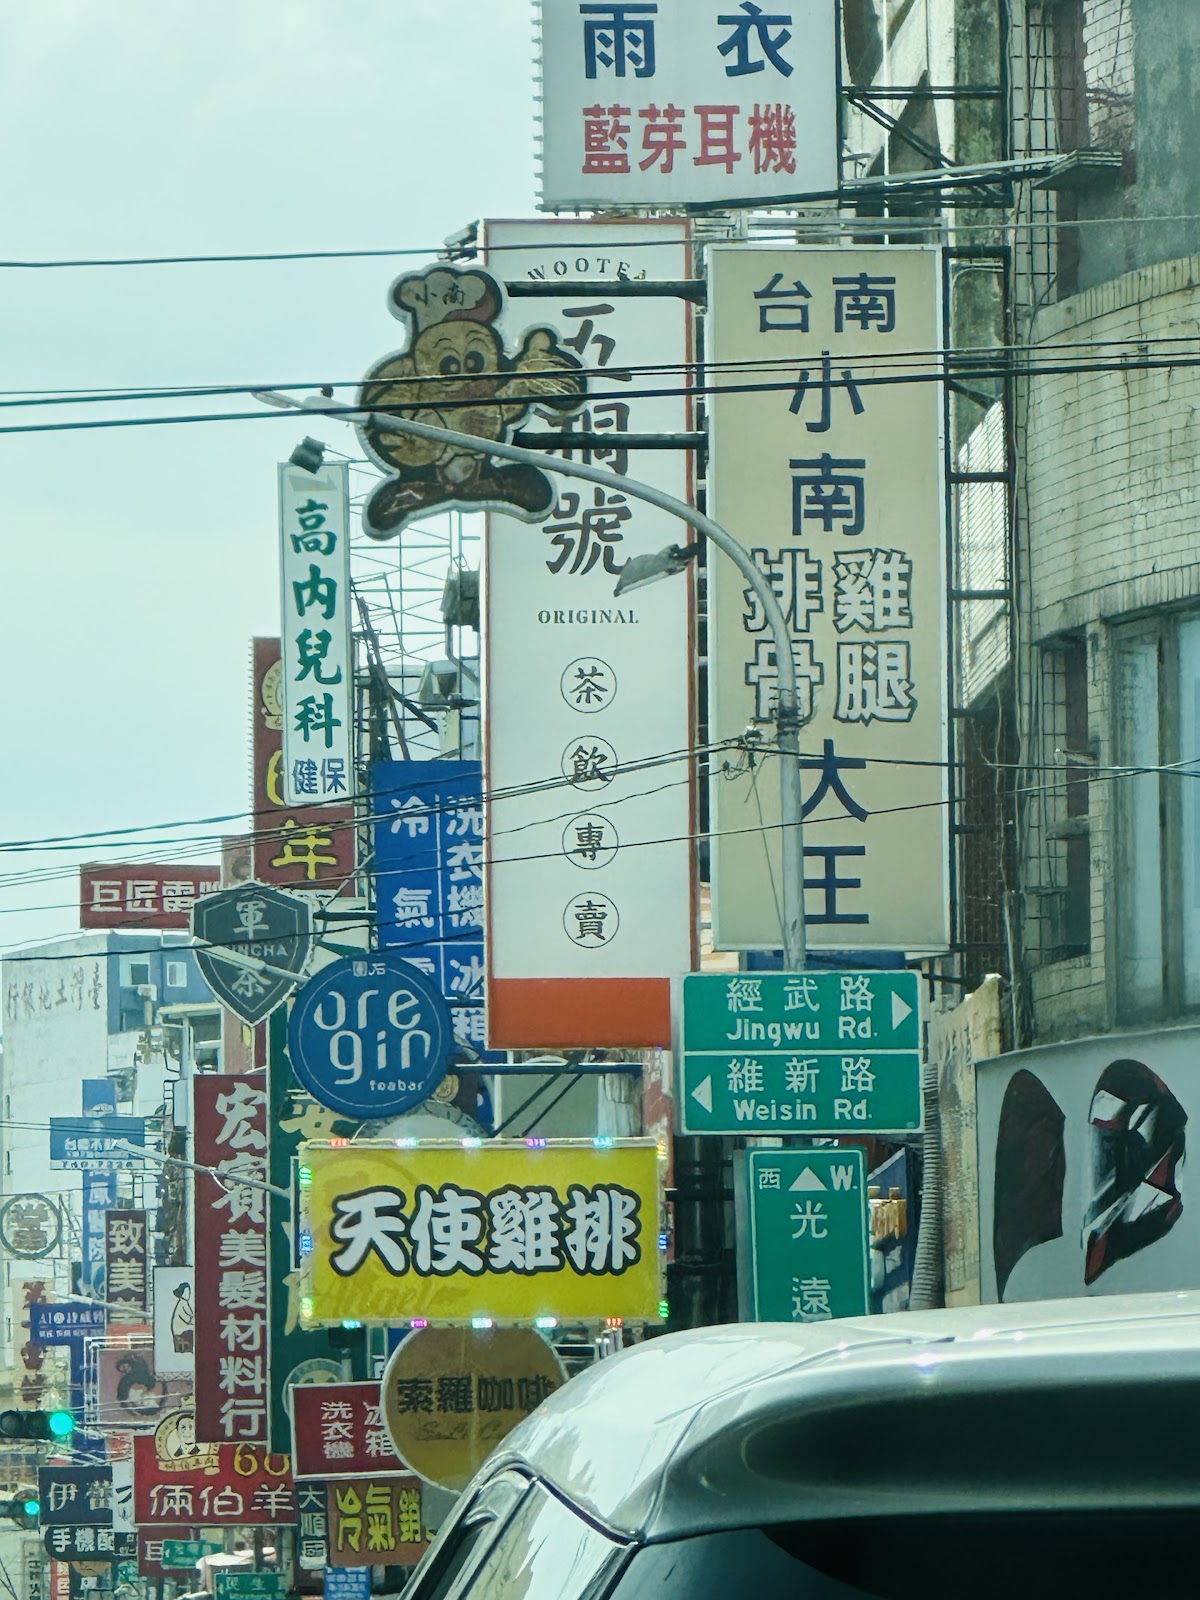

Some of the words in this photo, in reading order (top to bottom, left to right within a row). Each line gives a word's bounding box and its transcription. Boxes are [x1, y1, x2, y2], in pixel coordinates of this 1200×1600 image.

[579, 2, 794, 79] 雨衣
[582, 103, 797, 174] 藍芽耳機
[753, 272, 896, 333] 台南
[789, 350, 866, 536] 小南
[290, 498, 342, 749] 高內兒科
[537, 609, 639, 625] ORIGINAL
[831, 548, 918, 727] 雞腿
[291, 757, 347, 796] 健保
[800, 738, 870, 925] 大王
[726, 976, 875, 1013] 經武路
[726, 1017, 821, 1048] Jingwu
[838, 1016, 879, 1040] Rd.
[727, 1056, 876, 1094] 維新路
[733, 1099, 818, 1122] Weisin
[834, 1098, 874, 1121] Rd.
[758, 1167, 782, 1190] 西
[330, 1183, 642, 1277] 天使雞排
[789, 1200, 833, 1319] 光遠
[320, 1400, 354, 1459] 洗衣機
[149, 1483, 295, 1519] 倆伯羊
